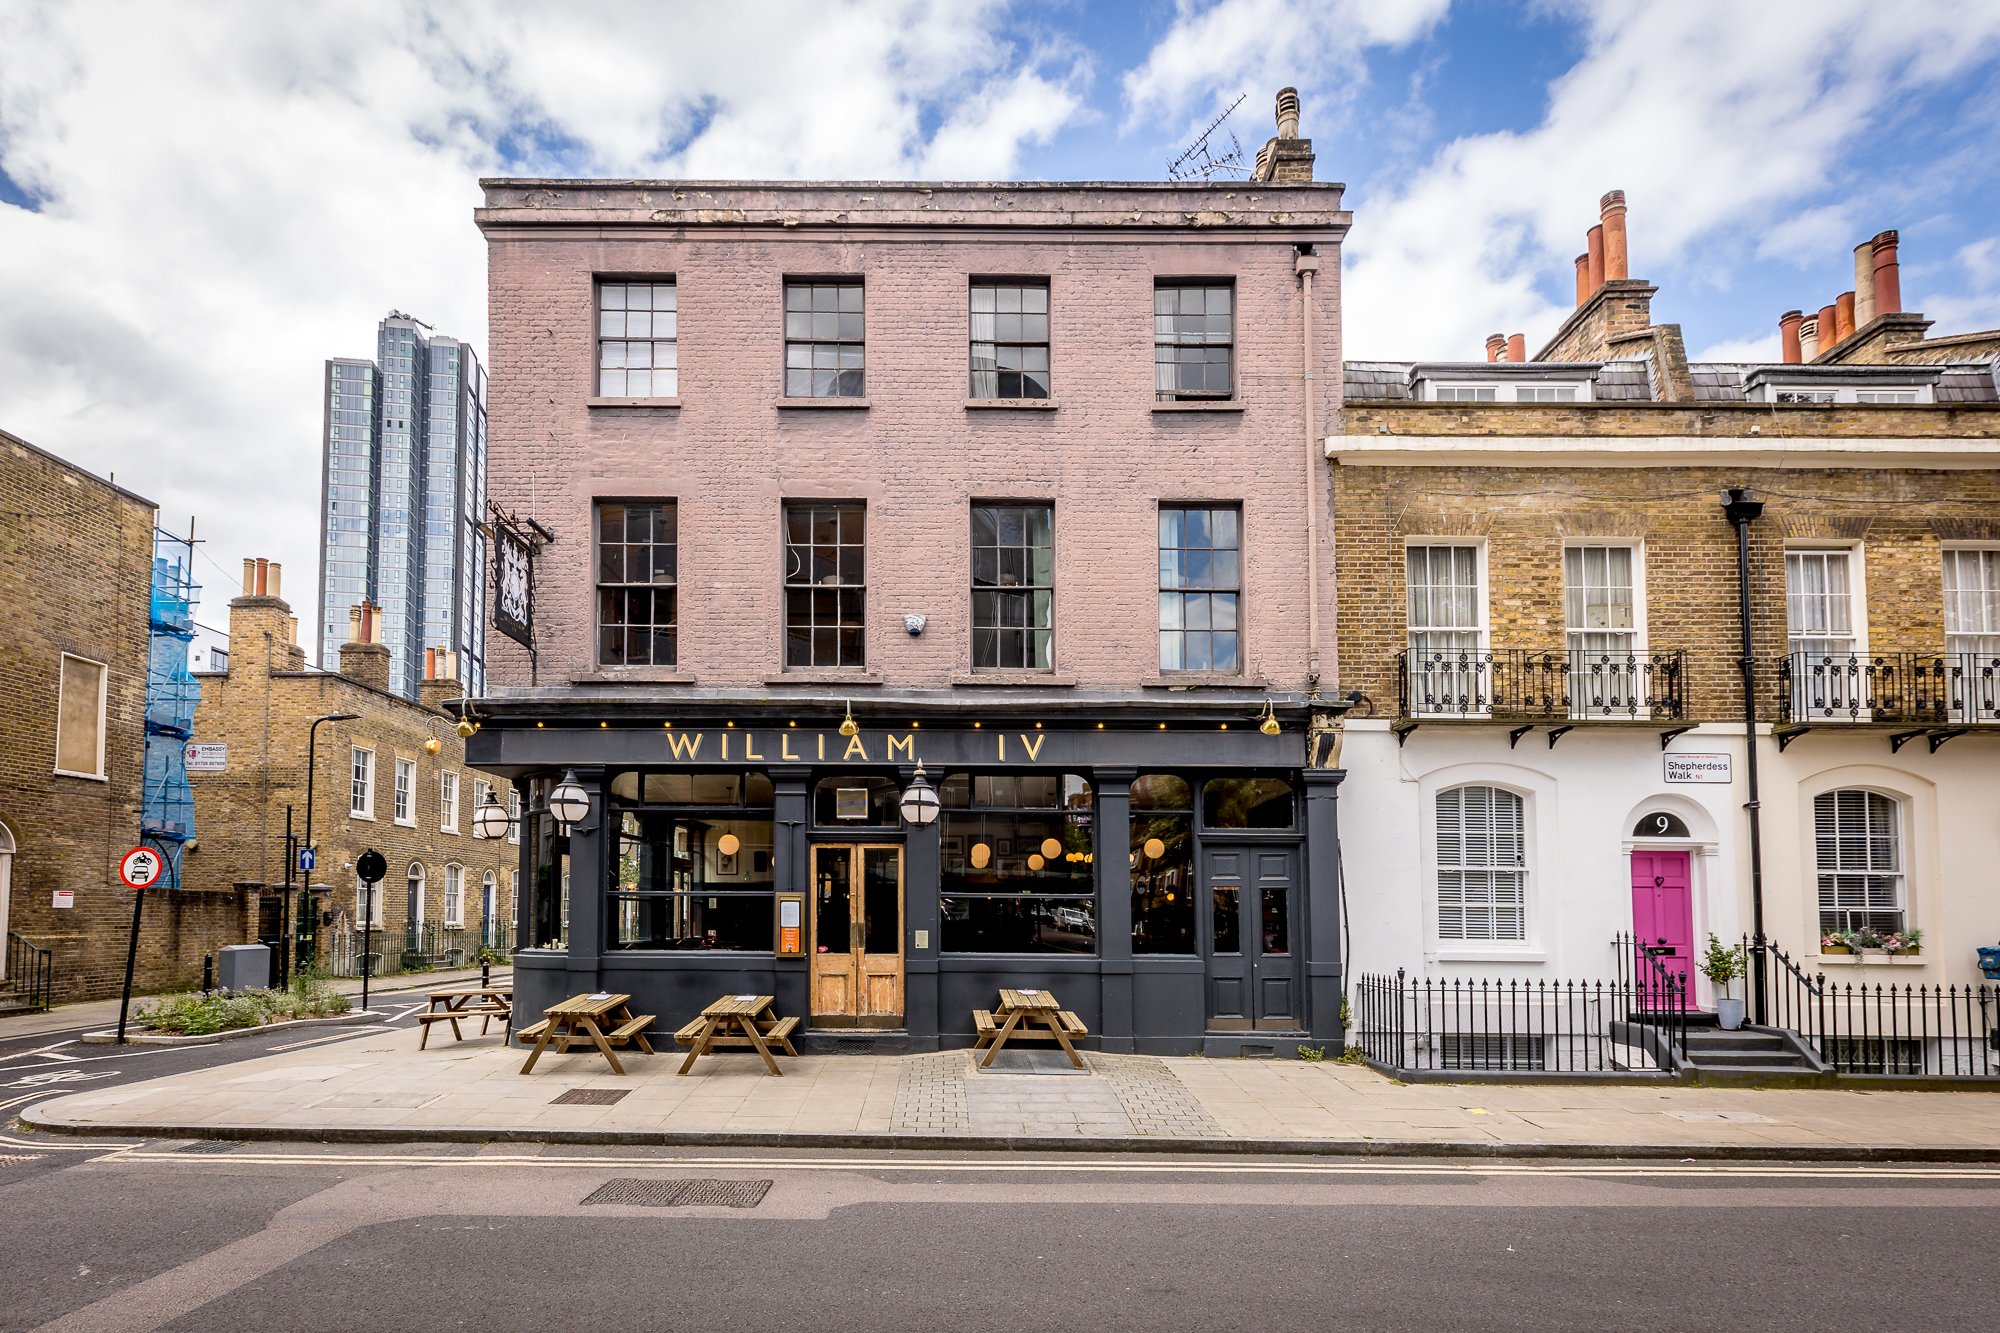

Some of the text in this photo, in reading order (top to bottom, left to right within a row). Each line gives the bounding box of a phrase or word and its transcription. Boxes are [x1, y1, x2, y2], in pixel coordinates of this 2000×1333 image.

[666, 733, 1046, 761] WILLIAM IV
[1668, 761, 1728, 771] Shepherdess
[1668, 771, 1692, 779] Walk
[1656, 816, 1669, 834] 9
